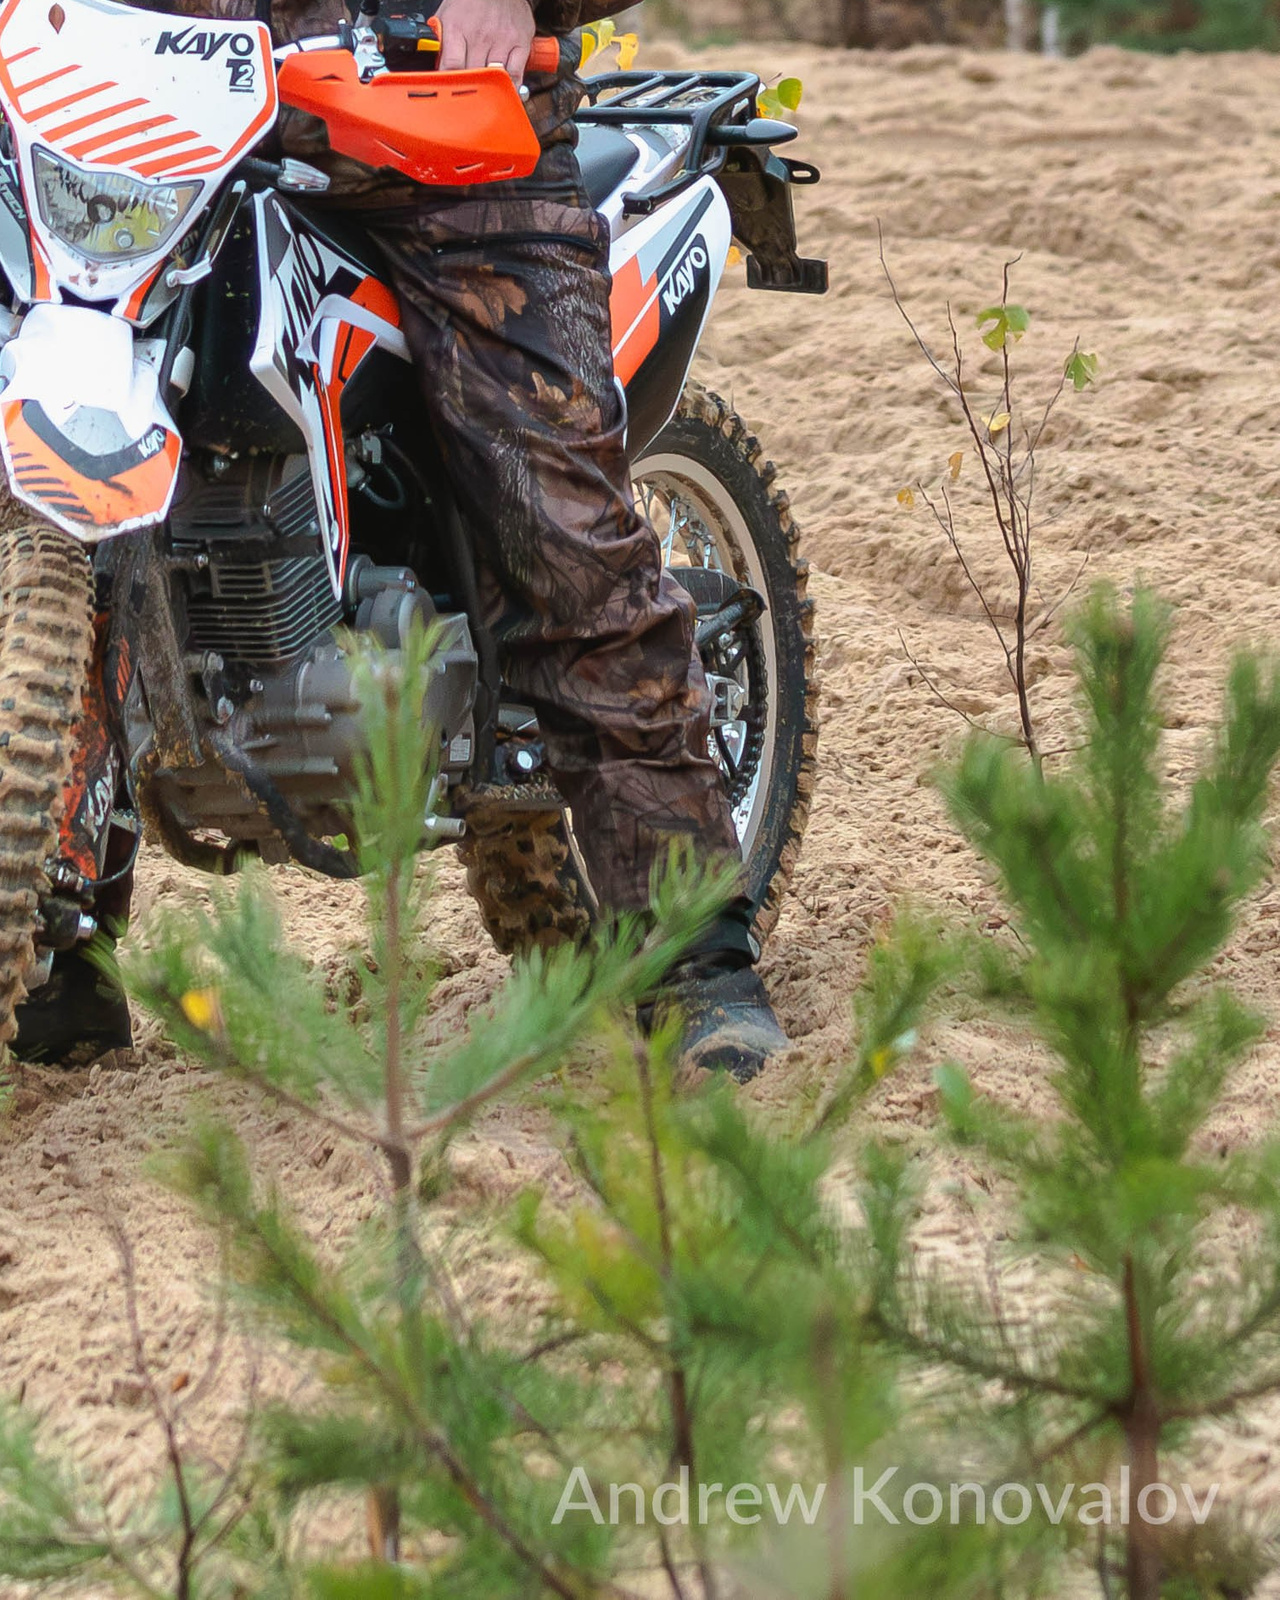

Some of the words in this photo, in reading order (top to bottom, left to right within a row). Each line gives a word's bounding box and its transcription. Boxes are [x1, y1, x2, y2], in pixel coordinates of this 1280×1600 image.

[154, 24, 255, 61] KAYO
[225, 58, 255, 88] T2
[661, 246, 707, 317] KAYO
